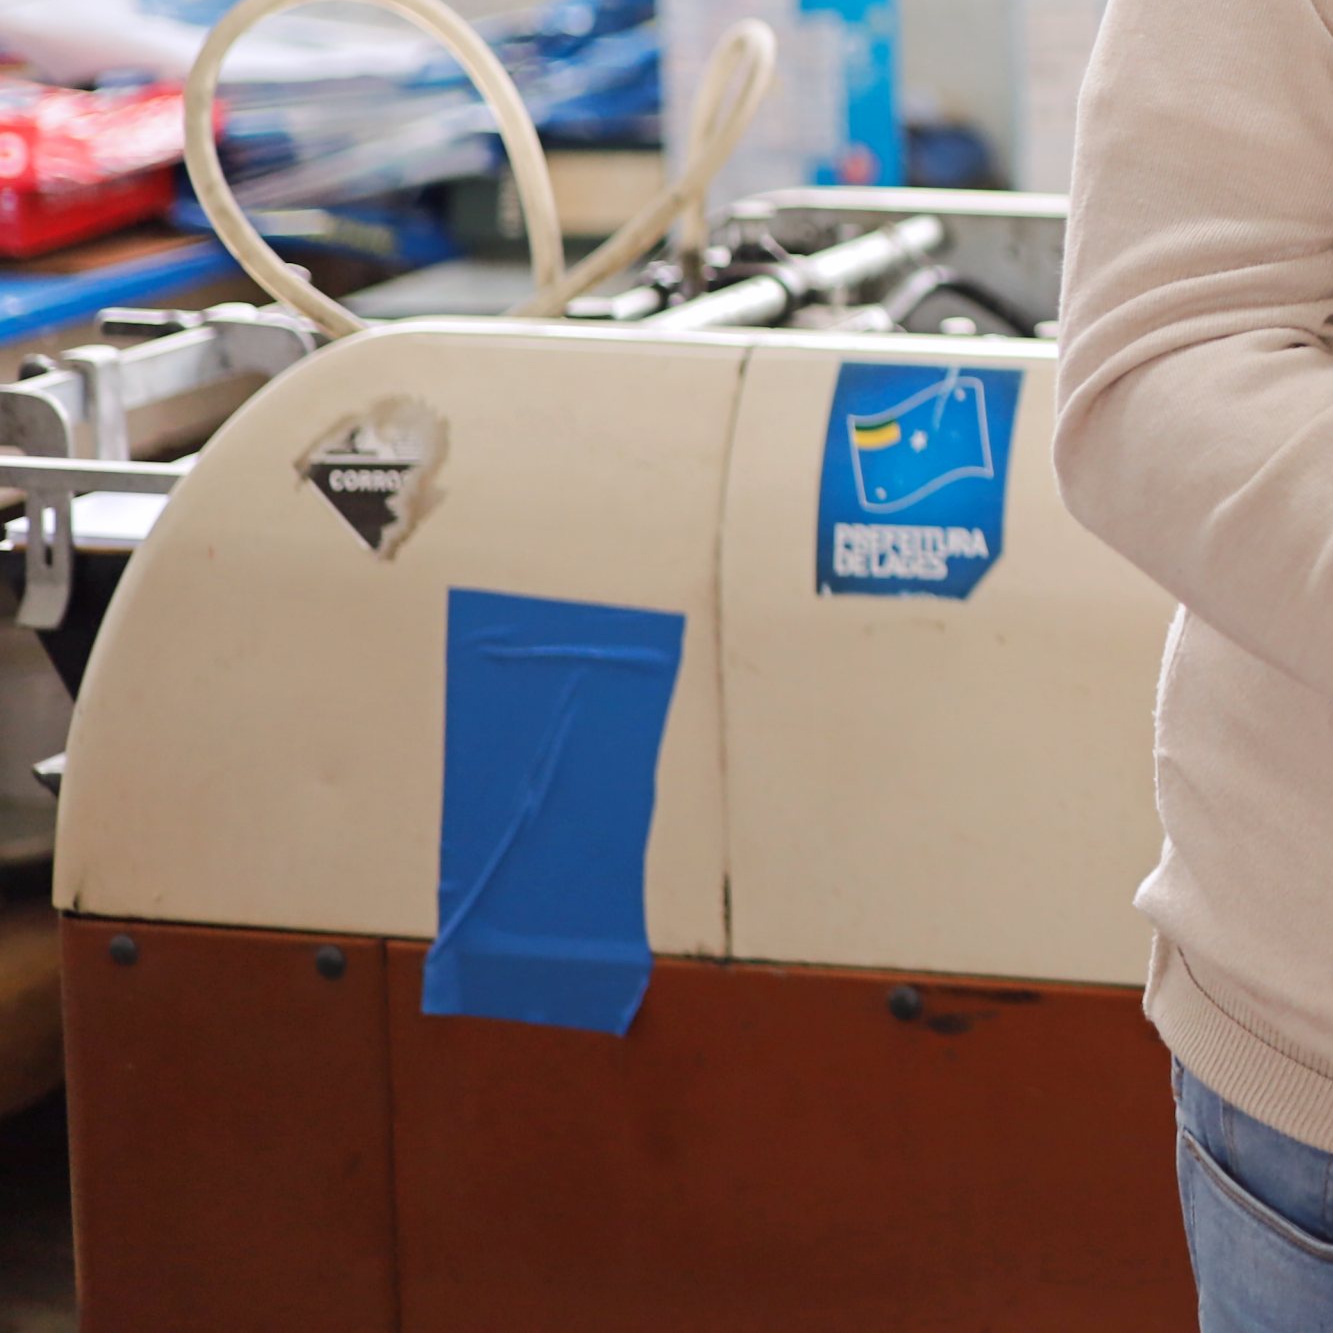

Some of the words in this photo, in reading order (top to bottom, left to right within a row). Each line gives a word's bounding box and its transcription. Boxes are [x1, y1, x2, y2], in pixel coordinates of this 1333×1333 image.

[833, 522, 989, 559] PREFEITURA
[833, 551, 869, 577] DE
[871, 551, 949, 581] LAGES
